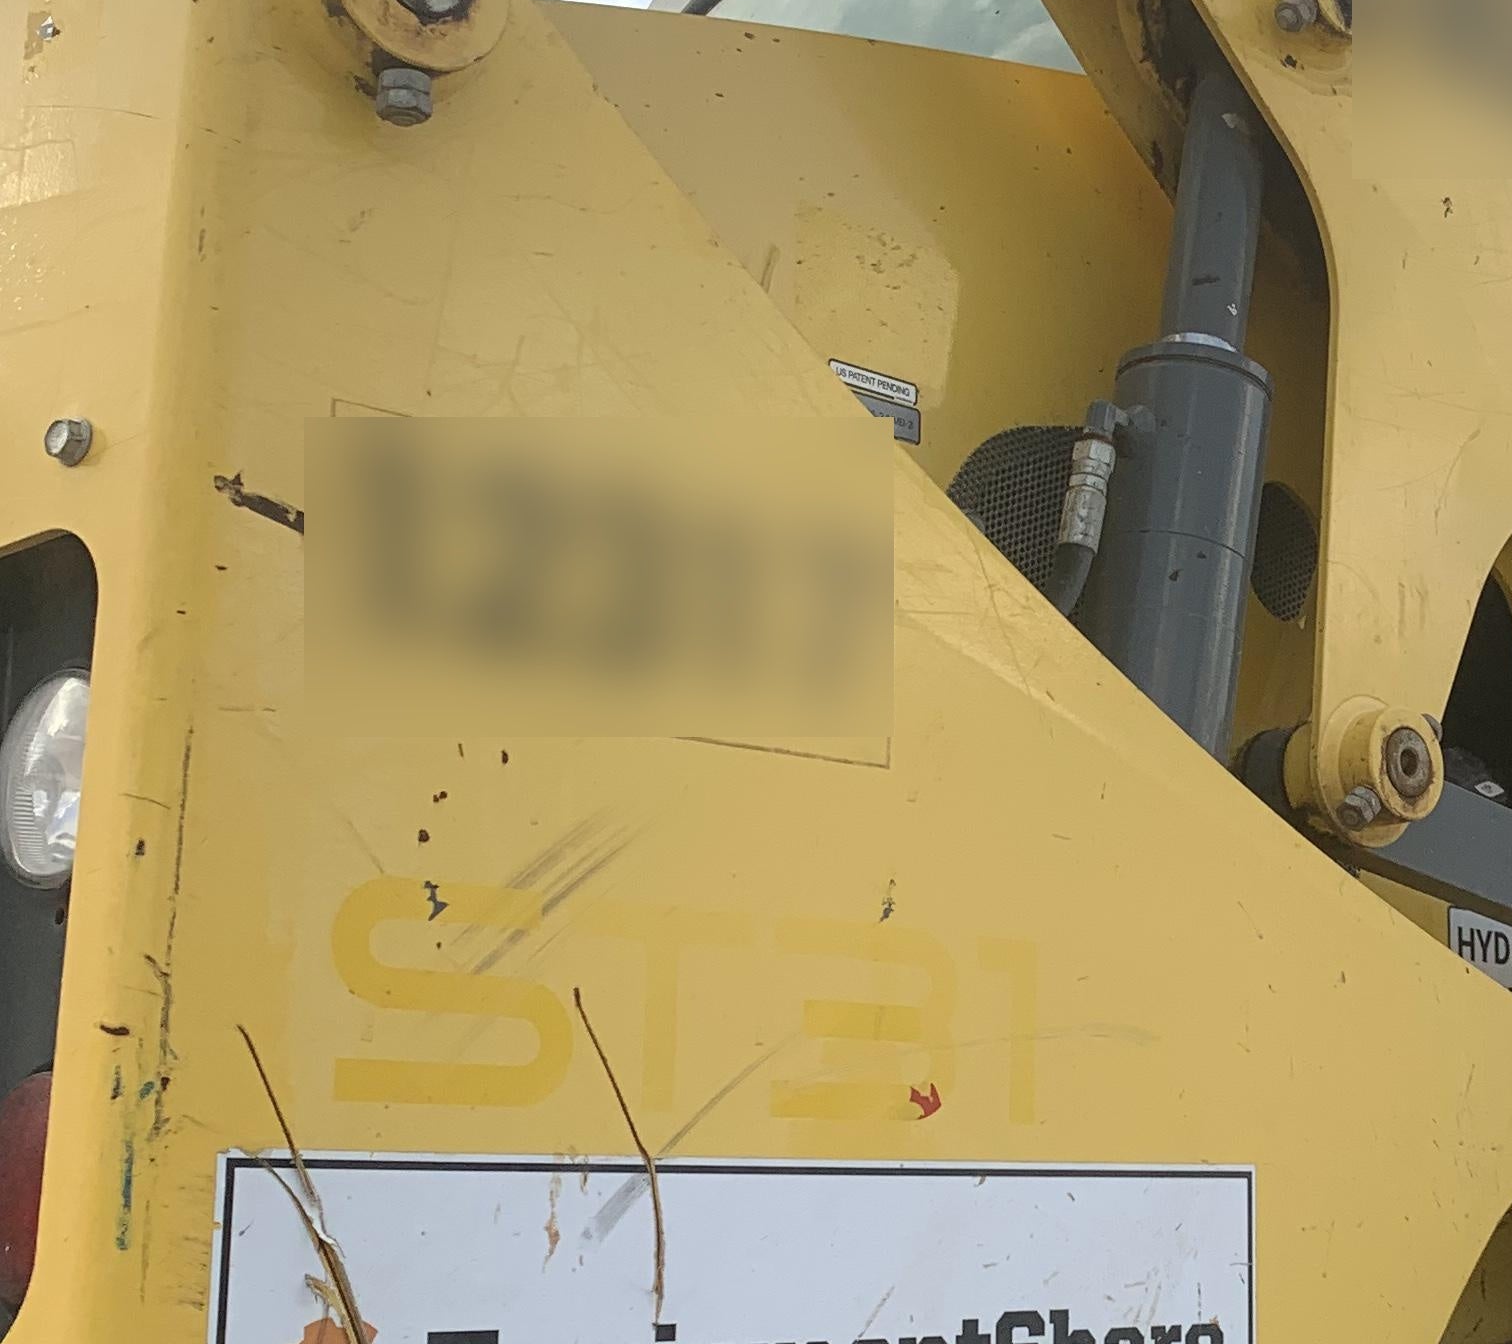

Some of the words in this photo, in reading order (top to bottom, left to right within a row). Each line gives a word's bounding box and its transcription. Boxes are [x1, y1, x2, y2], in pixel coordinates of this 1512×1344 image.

[835, 366, 847, 378] US
[848, 370, 876, 386] PATENT
[877, 379, 910, 397] PENDING
